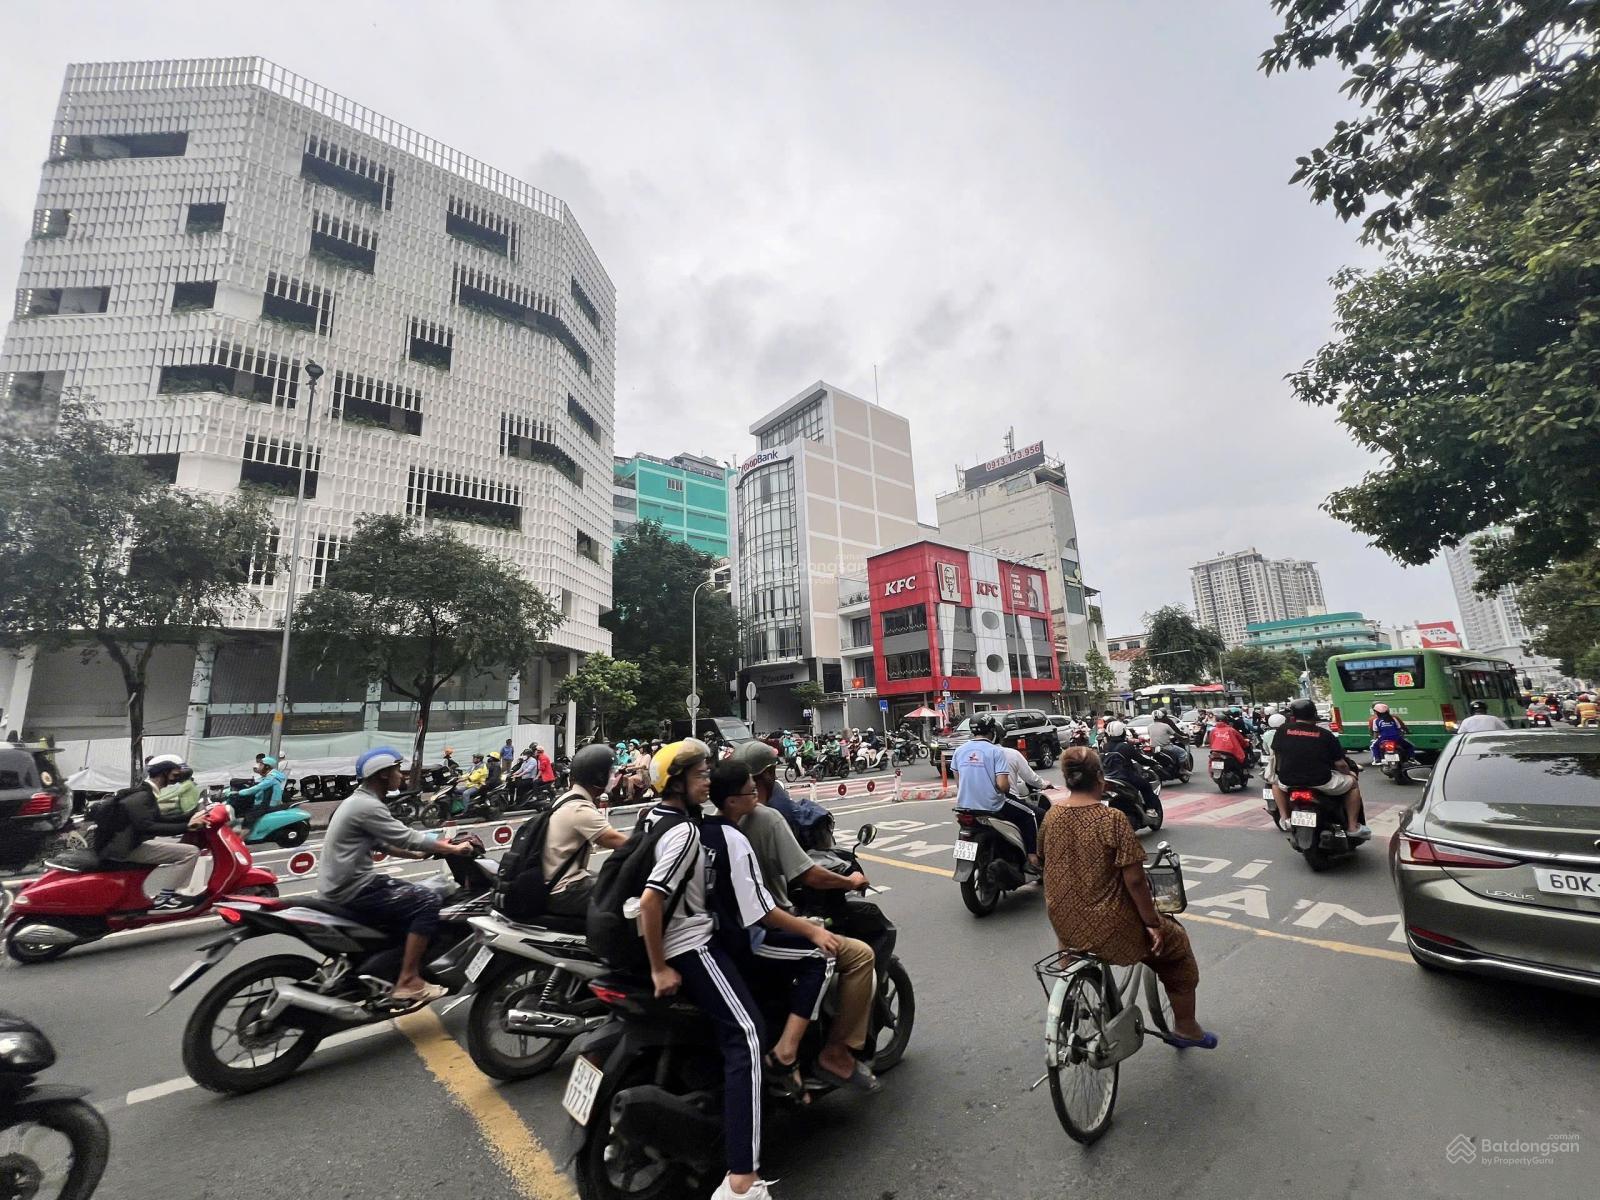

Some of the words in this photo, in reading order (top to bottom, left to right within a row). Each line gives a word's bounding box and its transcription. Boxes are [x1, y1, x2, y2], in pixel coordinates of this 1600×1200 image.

[986, 444, 1040, 471] 0913.173.956
[885, 576, 916, 596] KFC
[977, 581, 999, 597] KFC
[1397, 674, 1411, 685] 72
[1486, 889, 1536, 900] LEXUS
